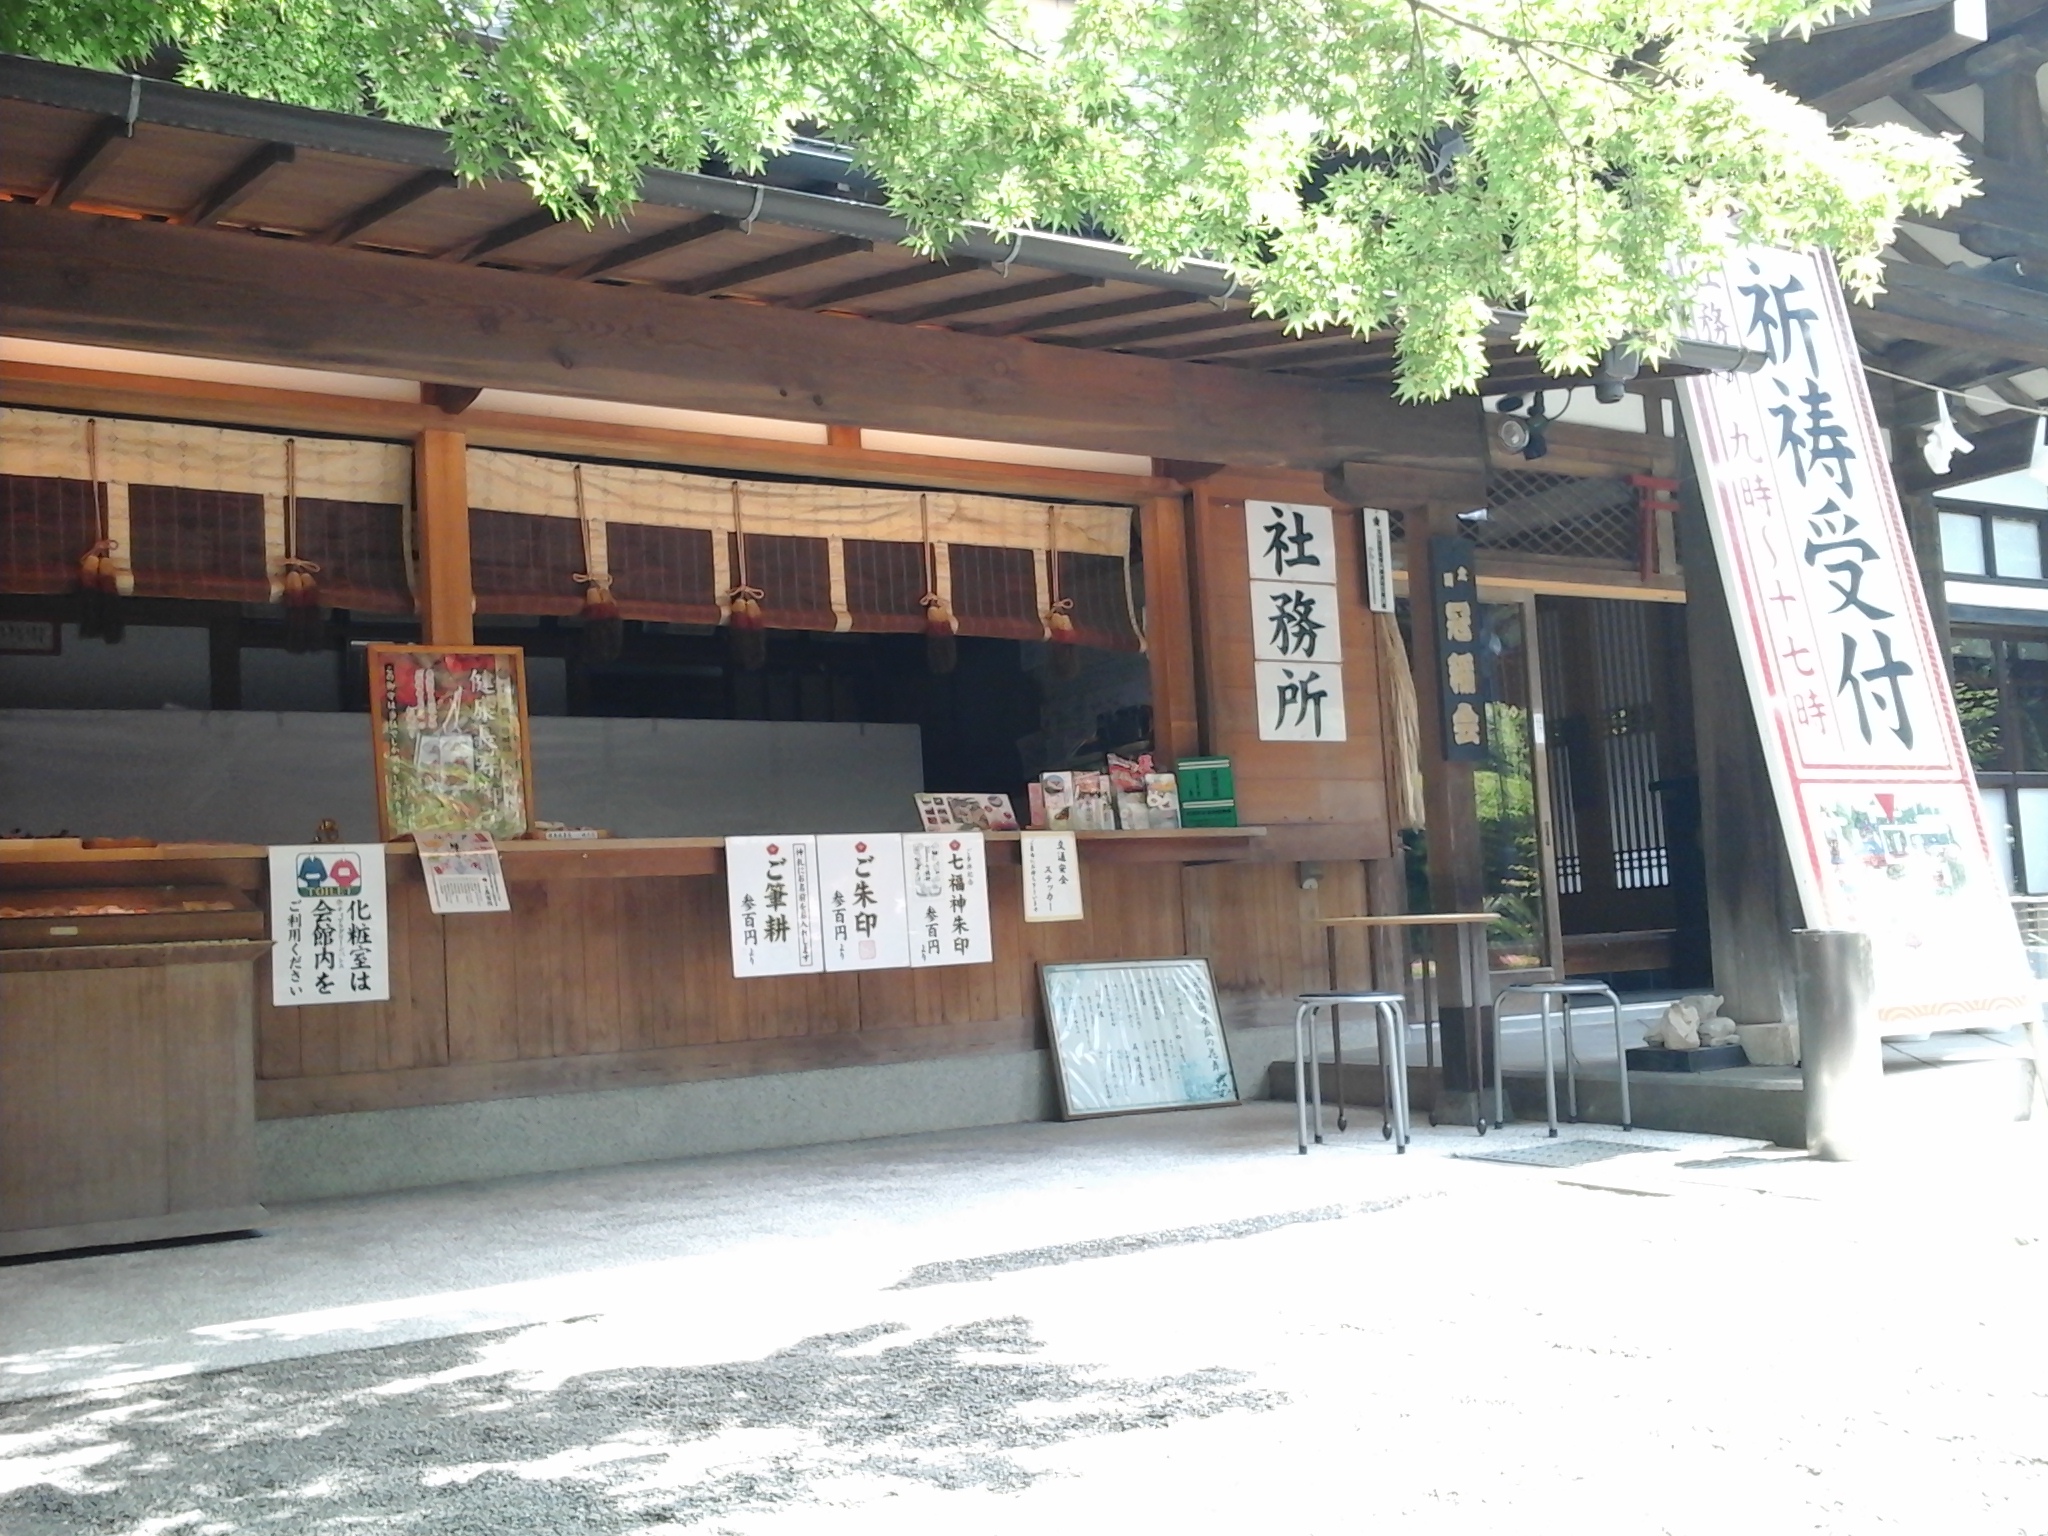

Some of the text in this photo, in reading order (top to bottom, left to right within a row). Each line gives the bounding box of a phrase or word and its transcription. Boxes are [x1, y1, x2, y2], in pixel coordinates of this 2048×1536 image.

[1736, 257, 1914, 751] 祈祷受付
[1262, 506, 1328, 738] 社務所
[763, 857, 792, 943] ご筆耕
[852, 855, 878, 939] ご朱印
[947, 853, 970, 956] 七福神朱印
[1044, 865, 1054, 912] ステッカー
[1056, 839, 1069, 884] 交通安全
[288, 900, 303, 996] ご利用ください
[311, 899, 337, 995] 会館内を
[346, 899, 372, 992] 化粧室は
